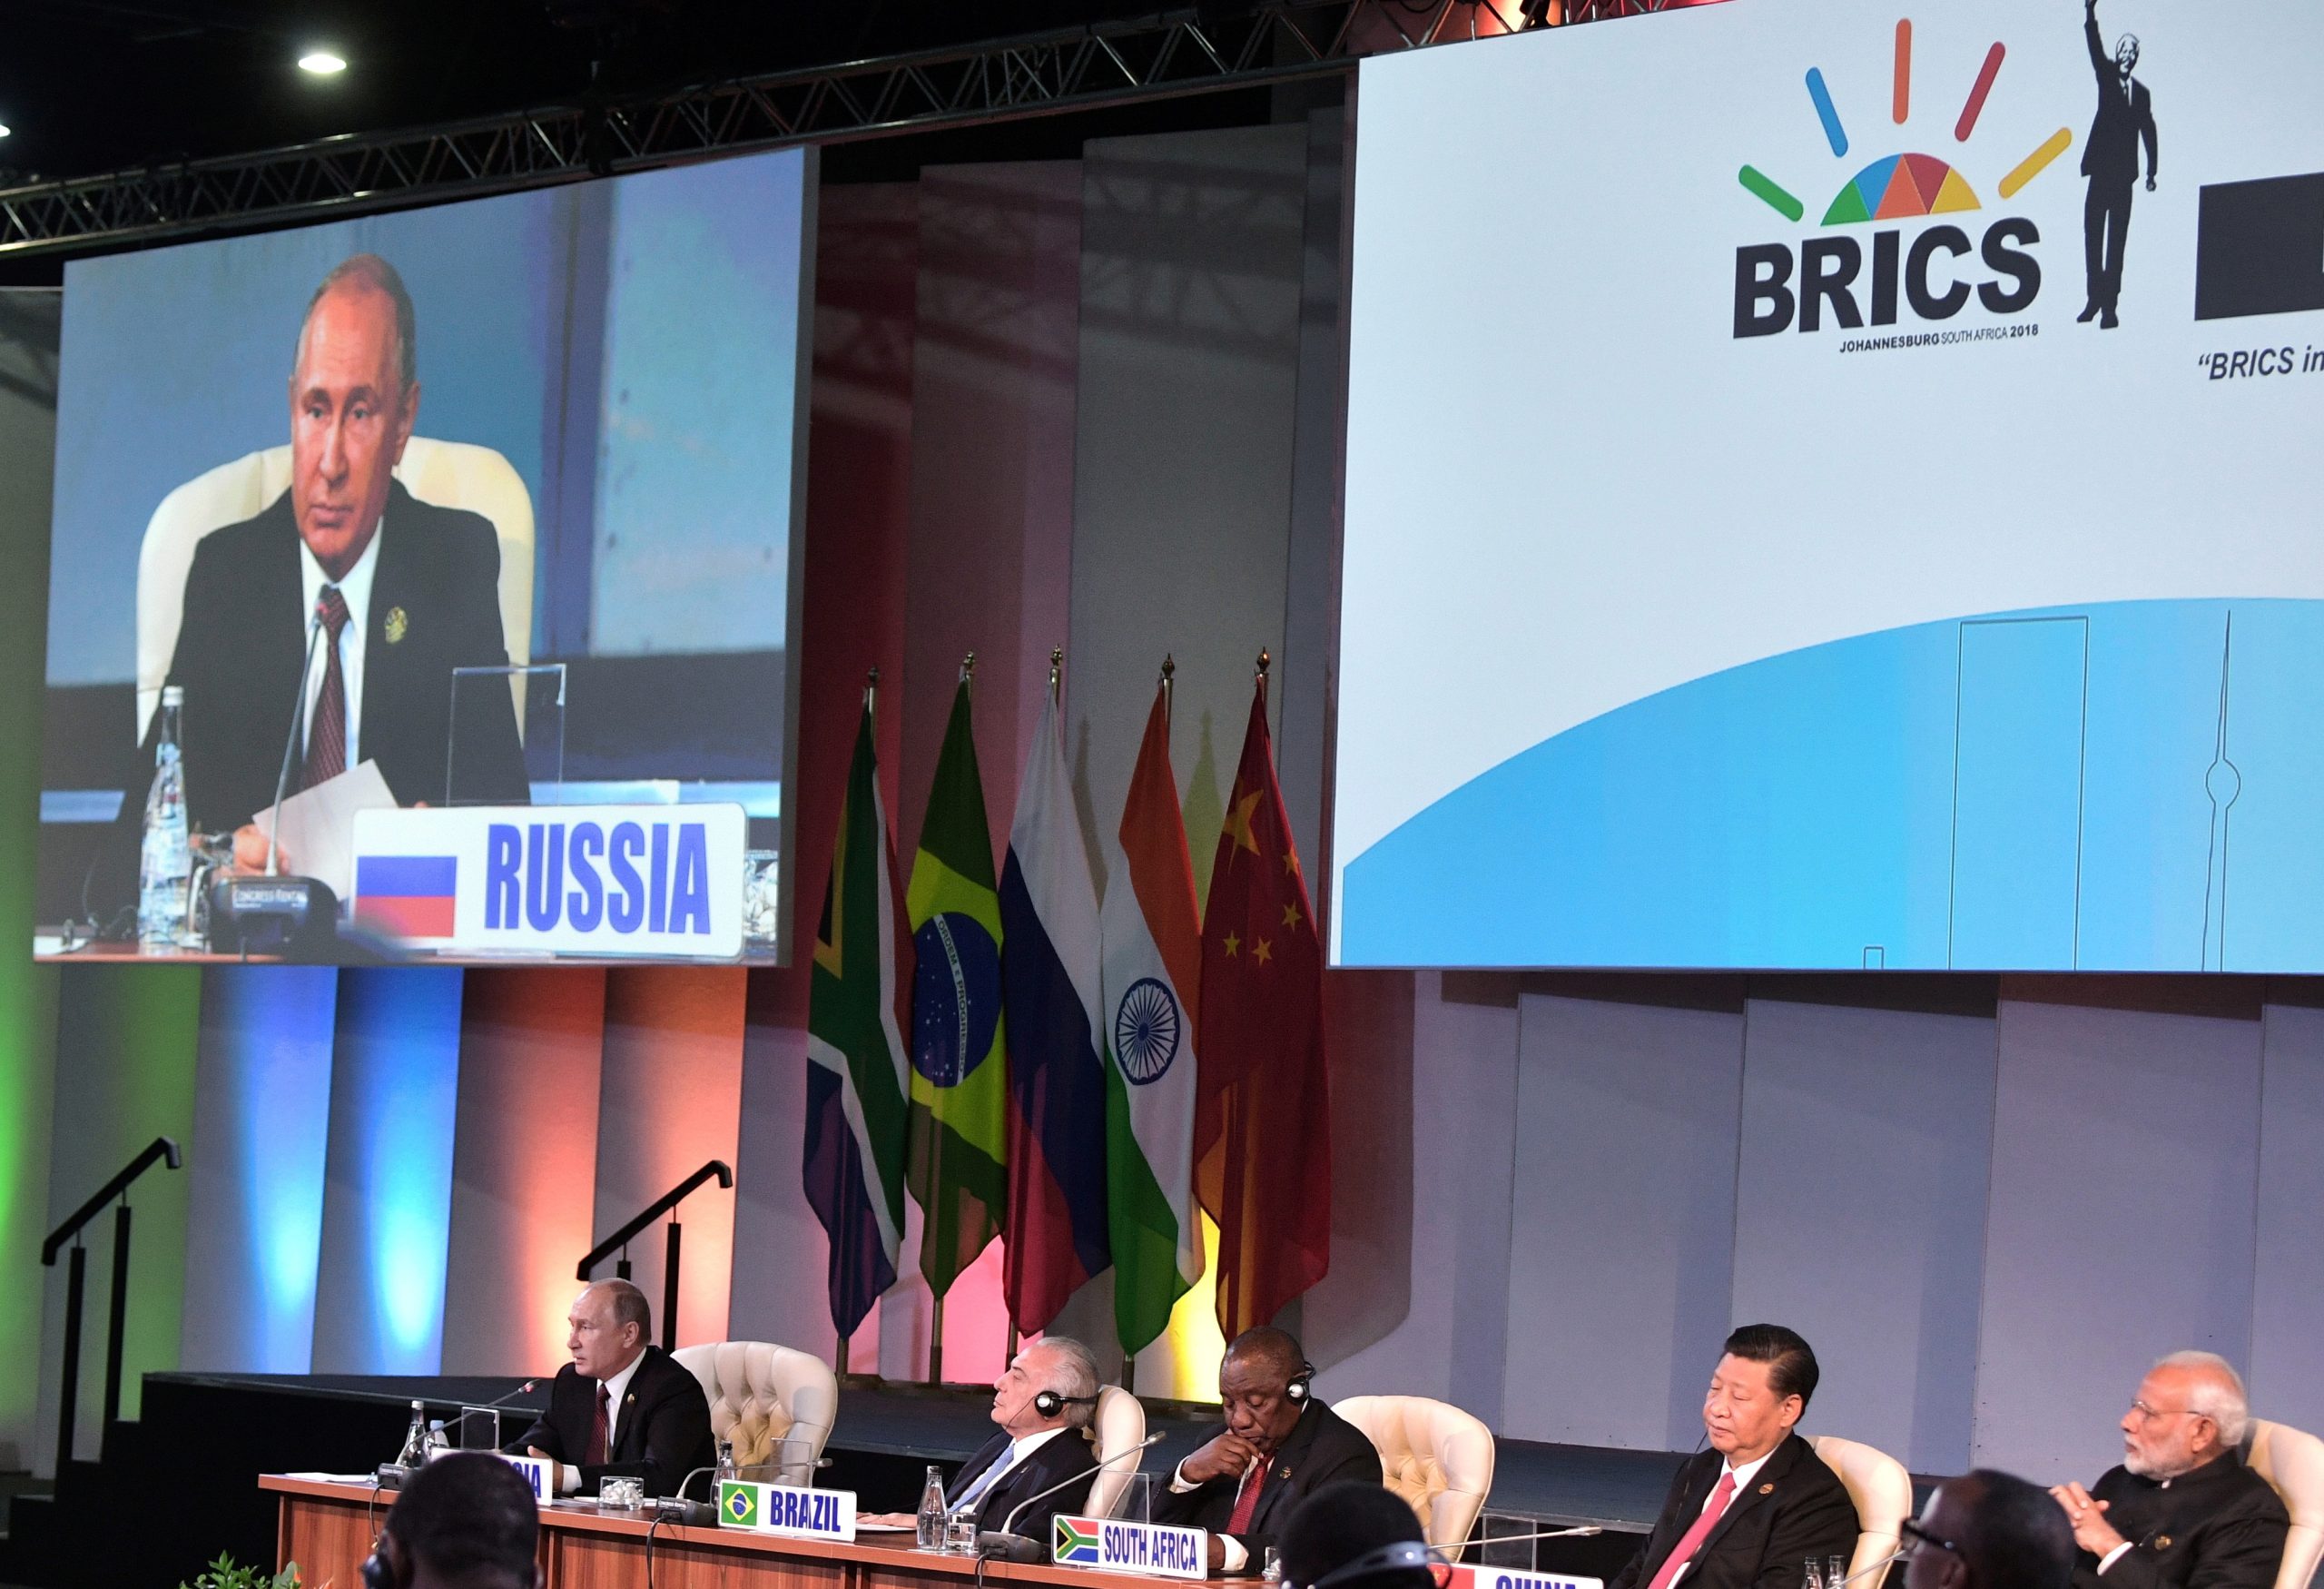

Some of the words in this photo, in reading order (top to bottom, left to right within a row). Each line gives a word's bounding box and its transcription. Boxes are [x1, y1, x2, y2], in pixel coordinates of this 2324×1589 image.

[1733, 216, 2043, 340] BRICS
[1839, 332, 1940, 353] JOHANNESBURG
[1940, 331, 1973, 346] SOUTH
[1973, 327, 2008, 342] AFRICA
[2009, 323, 2039, 339] 2018
[484, 820, 712, 936] RUSSIA
[770, 1490, 841, 1531] BRAZIL
[1105, 1525, 1147, 1564] SOUTH
[1151, 1531, 1197, 1571] AFRICA
